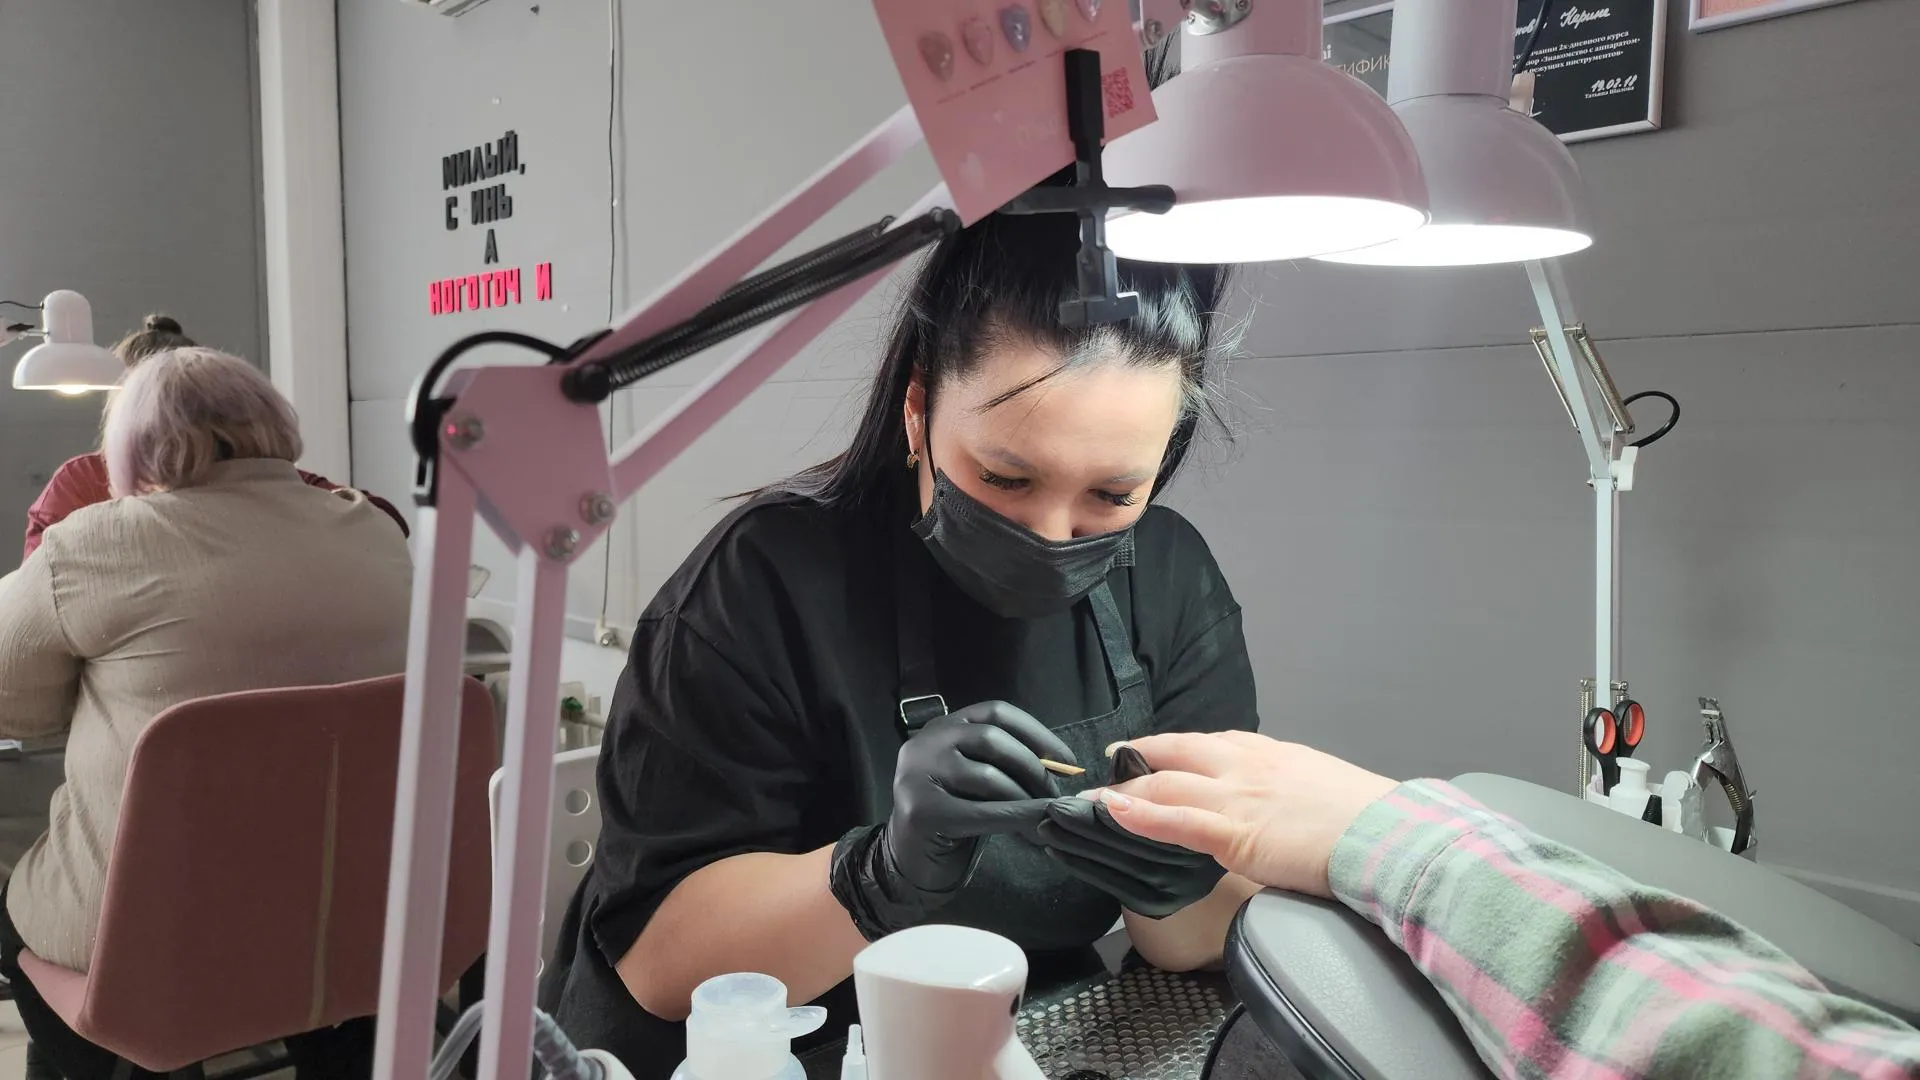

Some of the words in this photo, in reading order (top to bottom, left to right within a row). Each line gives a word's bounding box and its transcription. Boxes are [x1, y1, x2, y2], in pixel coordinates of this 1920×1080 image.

[1606, 31, 1629, 41] курса
[442, 129, 526, 190] МИЛЫЙ,
[484, 228, 499, 264] А
